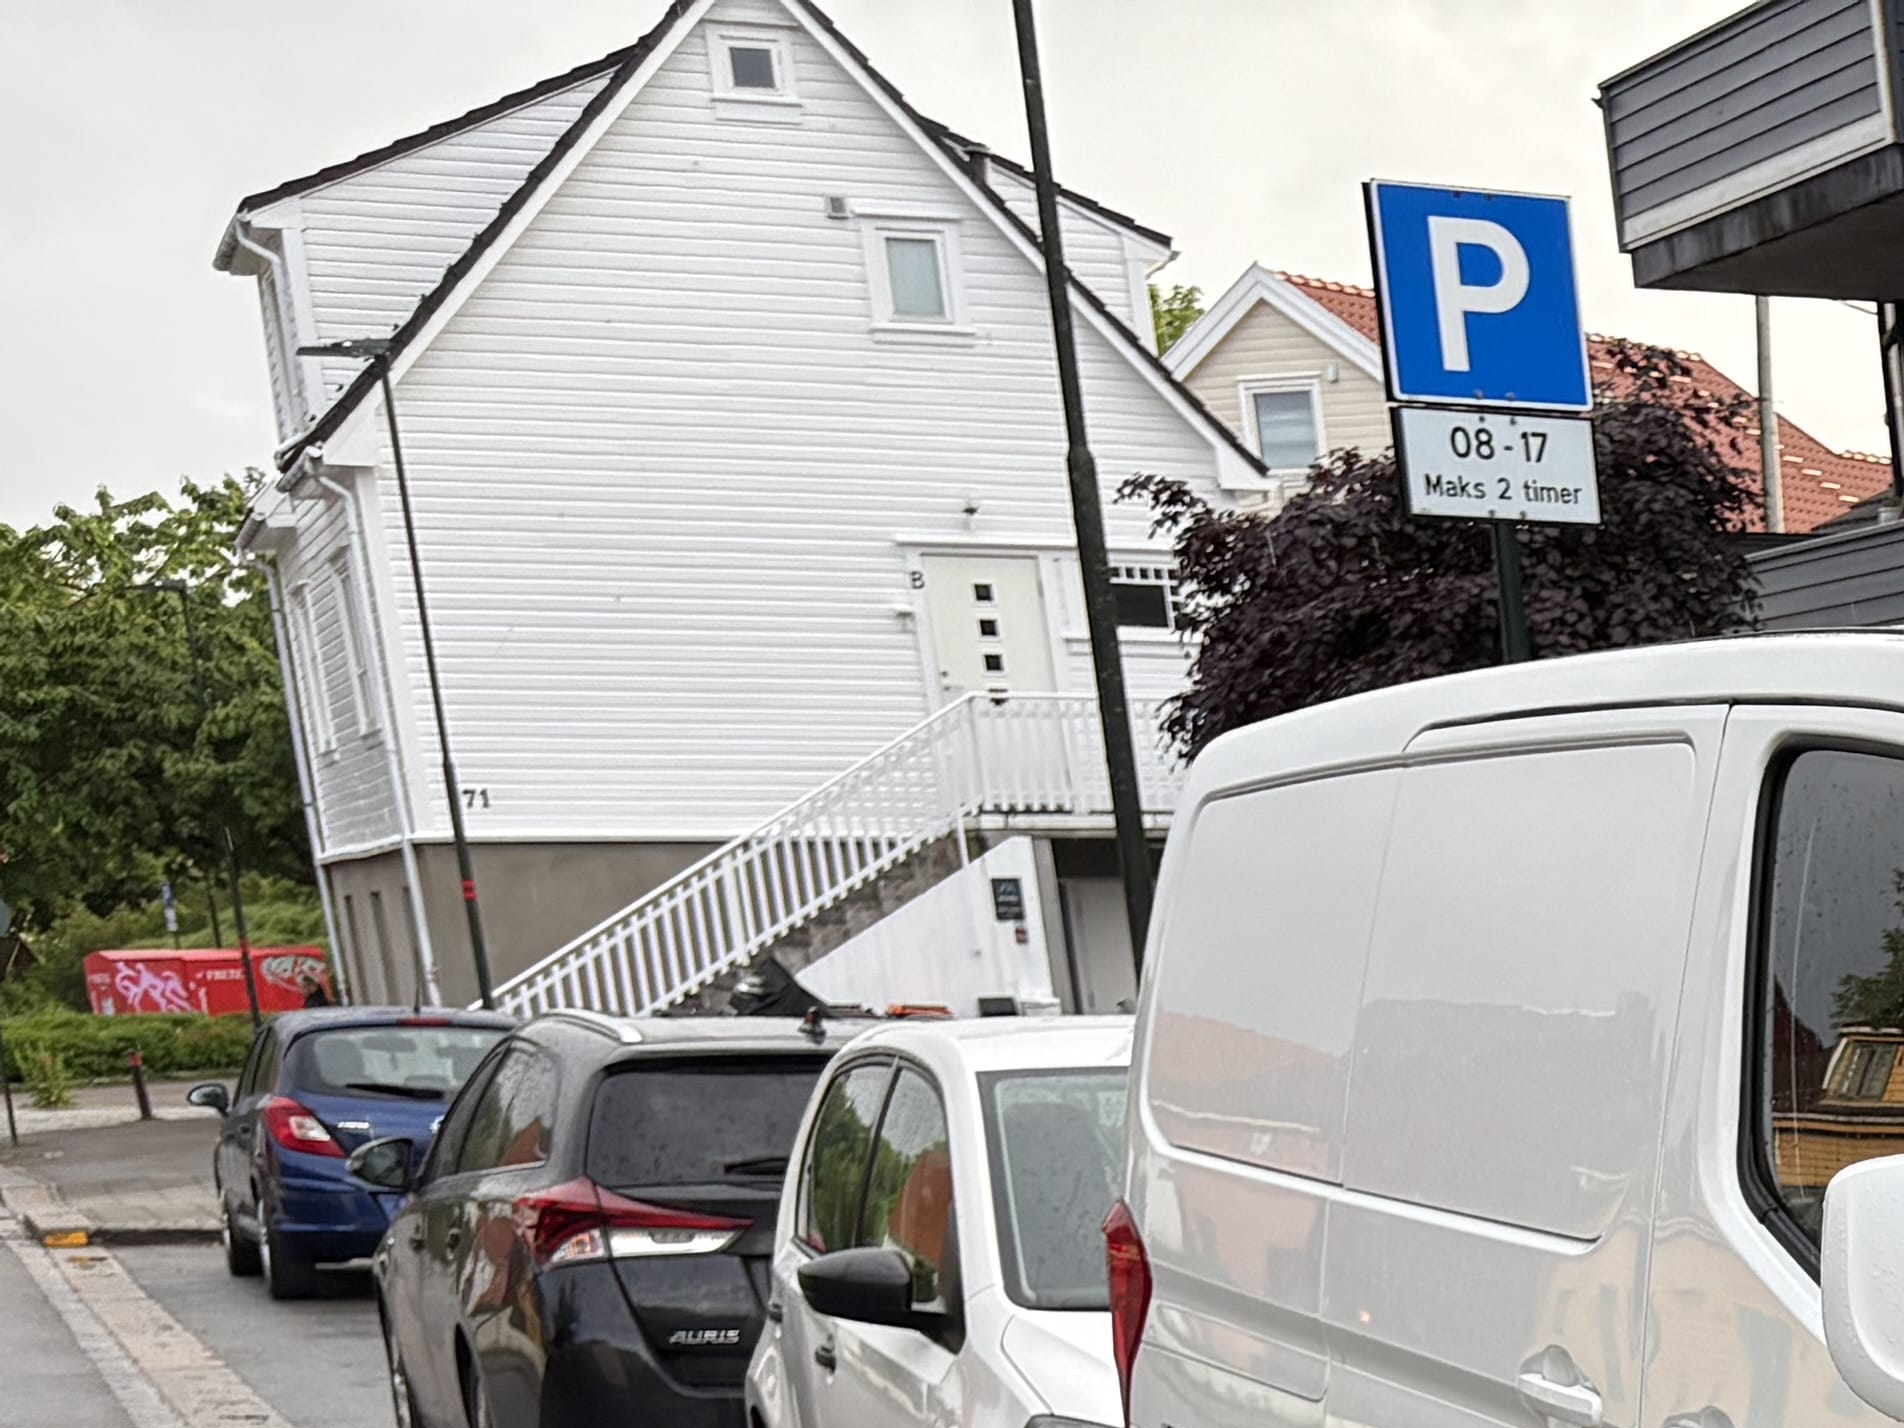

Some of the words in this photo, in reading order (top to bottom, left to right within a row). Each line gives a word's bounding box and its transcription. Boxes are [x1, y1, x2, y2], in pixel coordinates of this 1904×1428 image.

[1427, 215, 1530, 372] P
[1424, 474, 1486, 500] Maks
[1497, 478, 1512, 501] 2
[1522, 482, 1583, 505] timer
[911, 570, 925, 590] B
[462, 788, 490, 810] 71
[669, 1330, 740, 1345] AURIS
